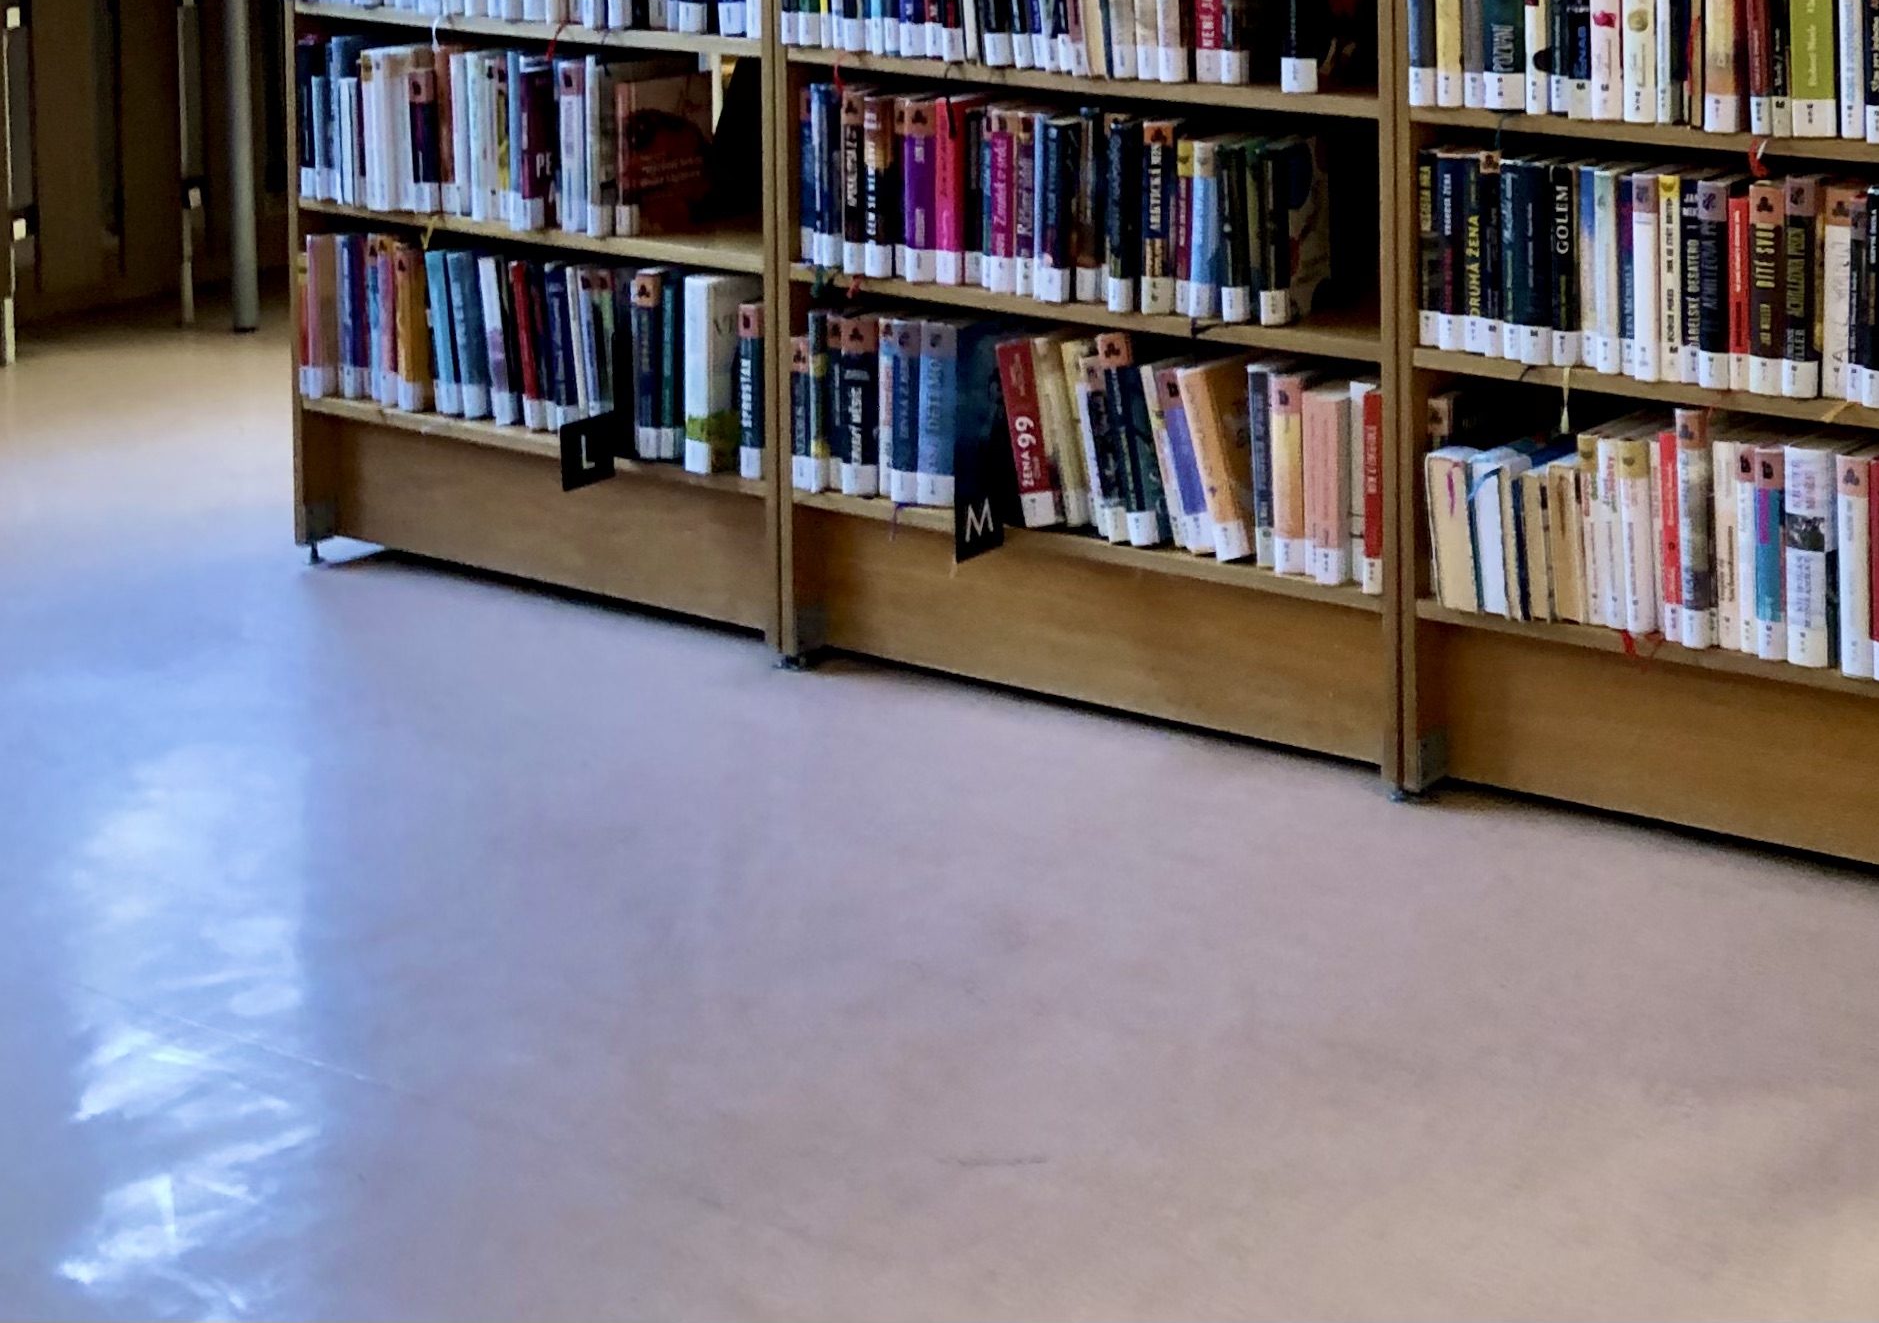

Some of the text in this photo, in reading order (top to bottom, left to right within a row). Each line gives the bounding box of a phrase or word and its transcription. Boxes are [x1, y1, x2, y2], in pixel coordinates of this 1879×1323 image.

[1554, 184, 1570, 255] GOLEM
[1465, 214, 1482, 318] DRUHÁ ŽENA
[580, 433, 595, 470] L
[1015, 415, 1037, 488] ŽENA 99
[964, 498, 995, 543] M
